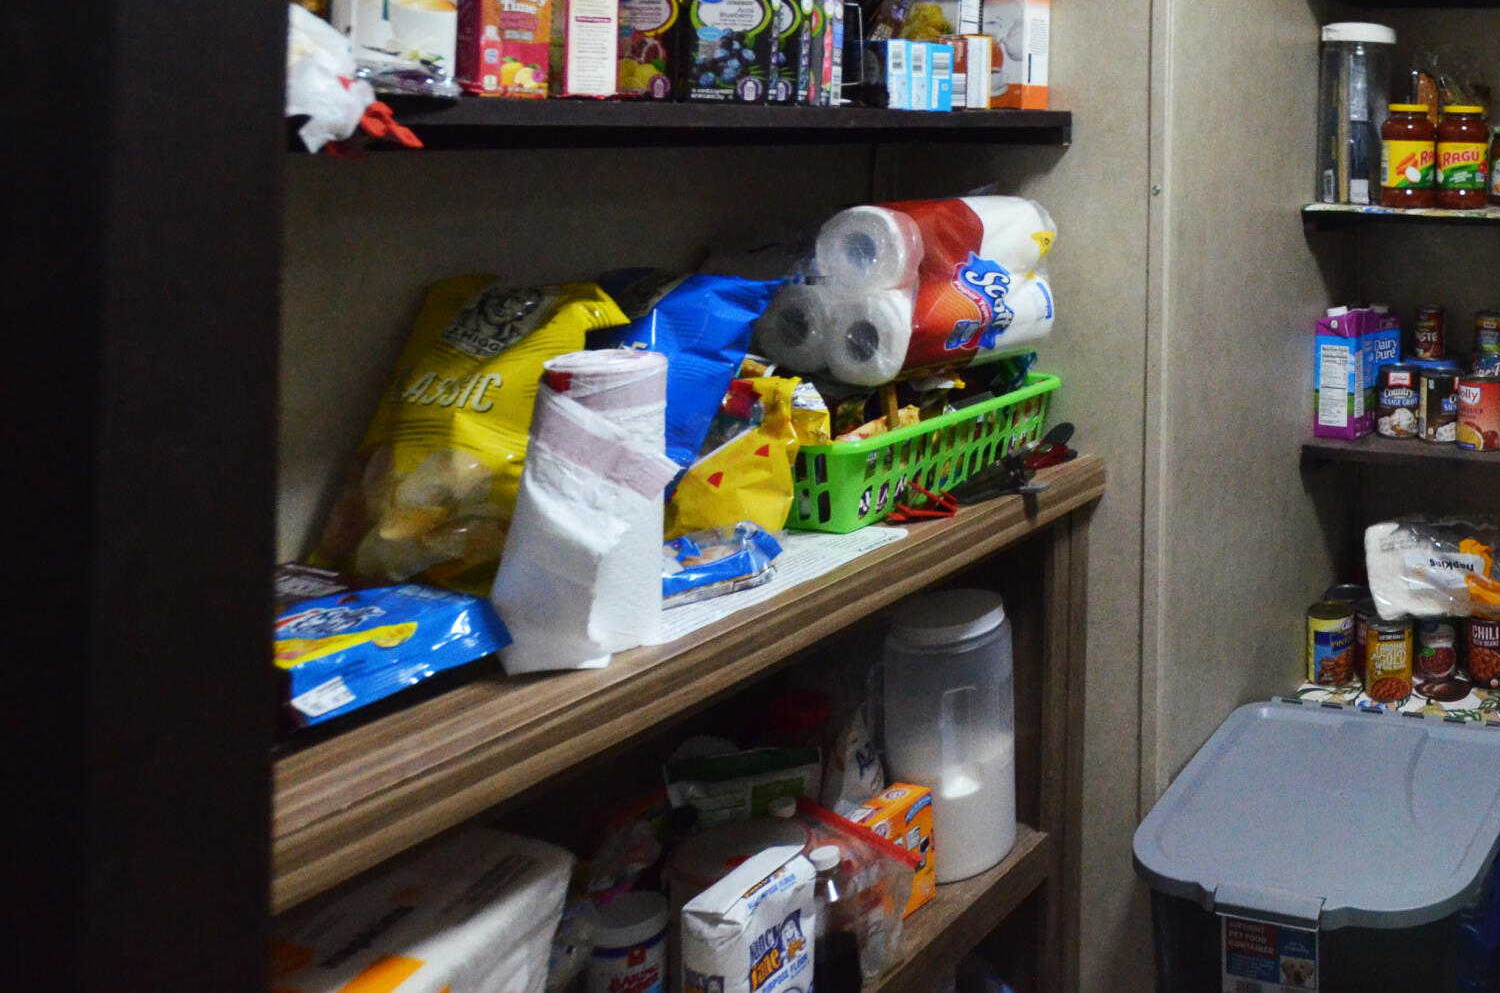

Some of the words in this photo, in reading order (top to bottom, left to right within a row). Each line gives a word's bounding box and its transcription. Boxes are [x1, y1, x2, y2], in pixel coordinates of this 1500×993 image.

[501, 0, 539, 15] Time
[1420, 150, 1435, 166] RA
[1442, 147, 1480, 166] RAGÚ
[964, 270, 1015, 330] Scott
[1374, 337, 1400, 352] Dairy
[1375, 348, 1396, 362] Pure
[1384, 387, 1414, 399] Country
[1429, 558, 1474, 572] napkins
[1472, 624, 1500, 639] CHILI
[1228, 939, 1275, 955] CONTAINER
